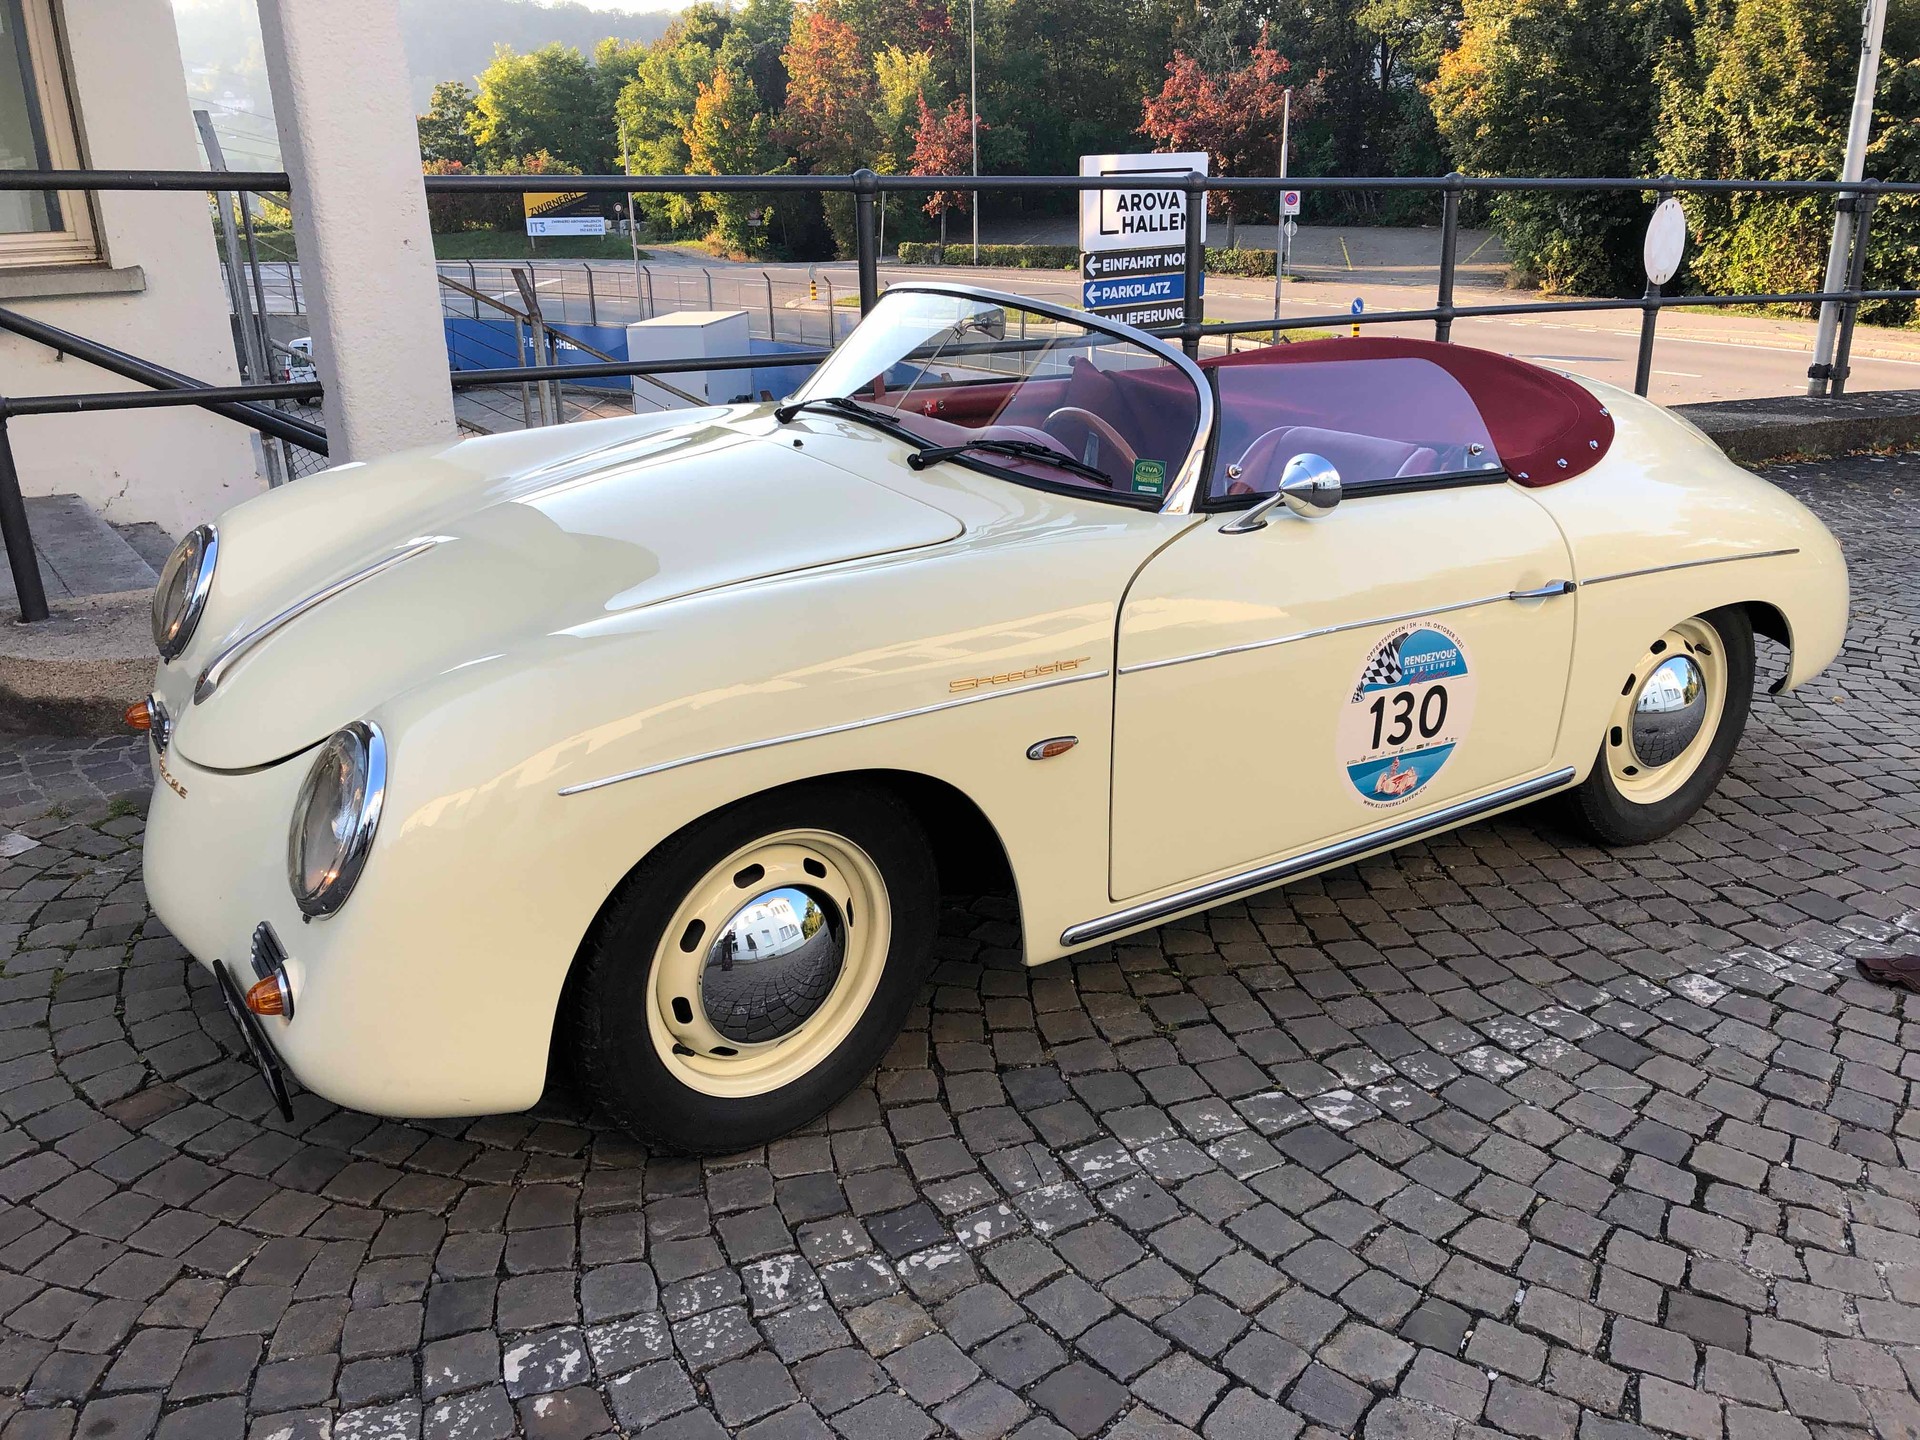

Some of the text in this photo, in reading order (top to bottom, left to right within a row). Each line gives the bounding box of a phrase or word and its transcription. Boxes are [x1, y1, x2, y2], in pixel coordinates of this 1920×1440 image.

[1116, 191, 1181, 213] AROVA
[529, 221, 546, 233] IT3
[1102, 255, 1162, 272] EINFAHRT
[1102, 281, 1171, 300] PARKPLATZ
[1141, 465, 1158, 473] FIVA
[1433, 622, 1456, 639] OKTOBER
[1404, 648, 1457, 666] RENDEZVOUS
[1403, 660, 1456, 676] AM KLEINEN
[1370, 684, 1448, 750] 130
